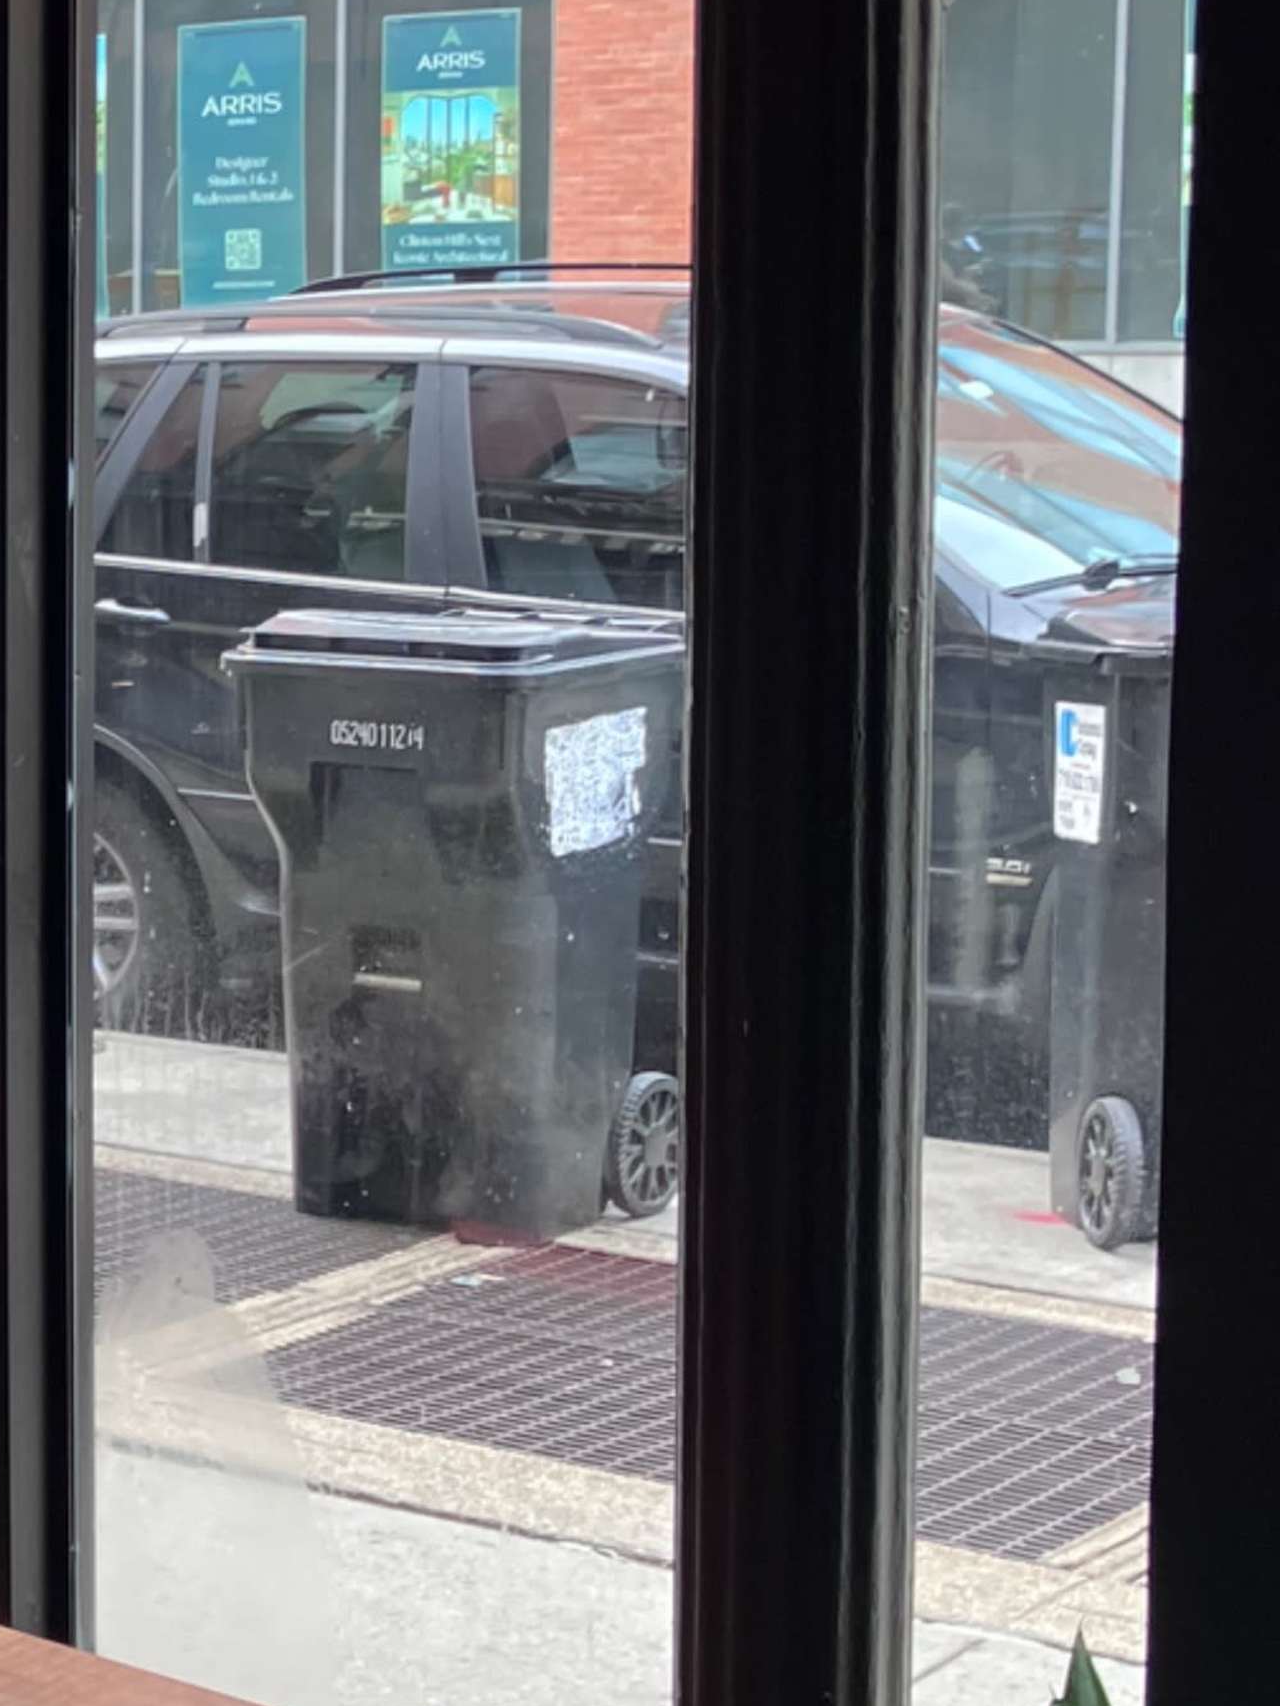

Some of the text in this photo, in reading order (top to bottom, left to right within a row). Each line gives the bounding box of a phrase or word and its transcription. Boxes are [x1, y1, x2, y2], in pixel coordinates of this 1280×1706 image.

[416, 50, 486, 72] ARRIS
[201, 92, 282, 117] ARRIS
[215, 157, 269, 173] Designer
